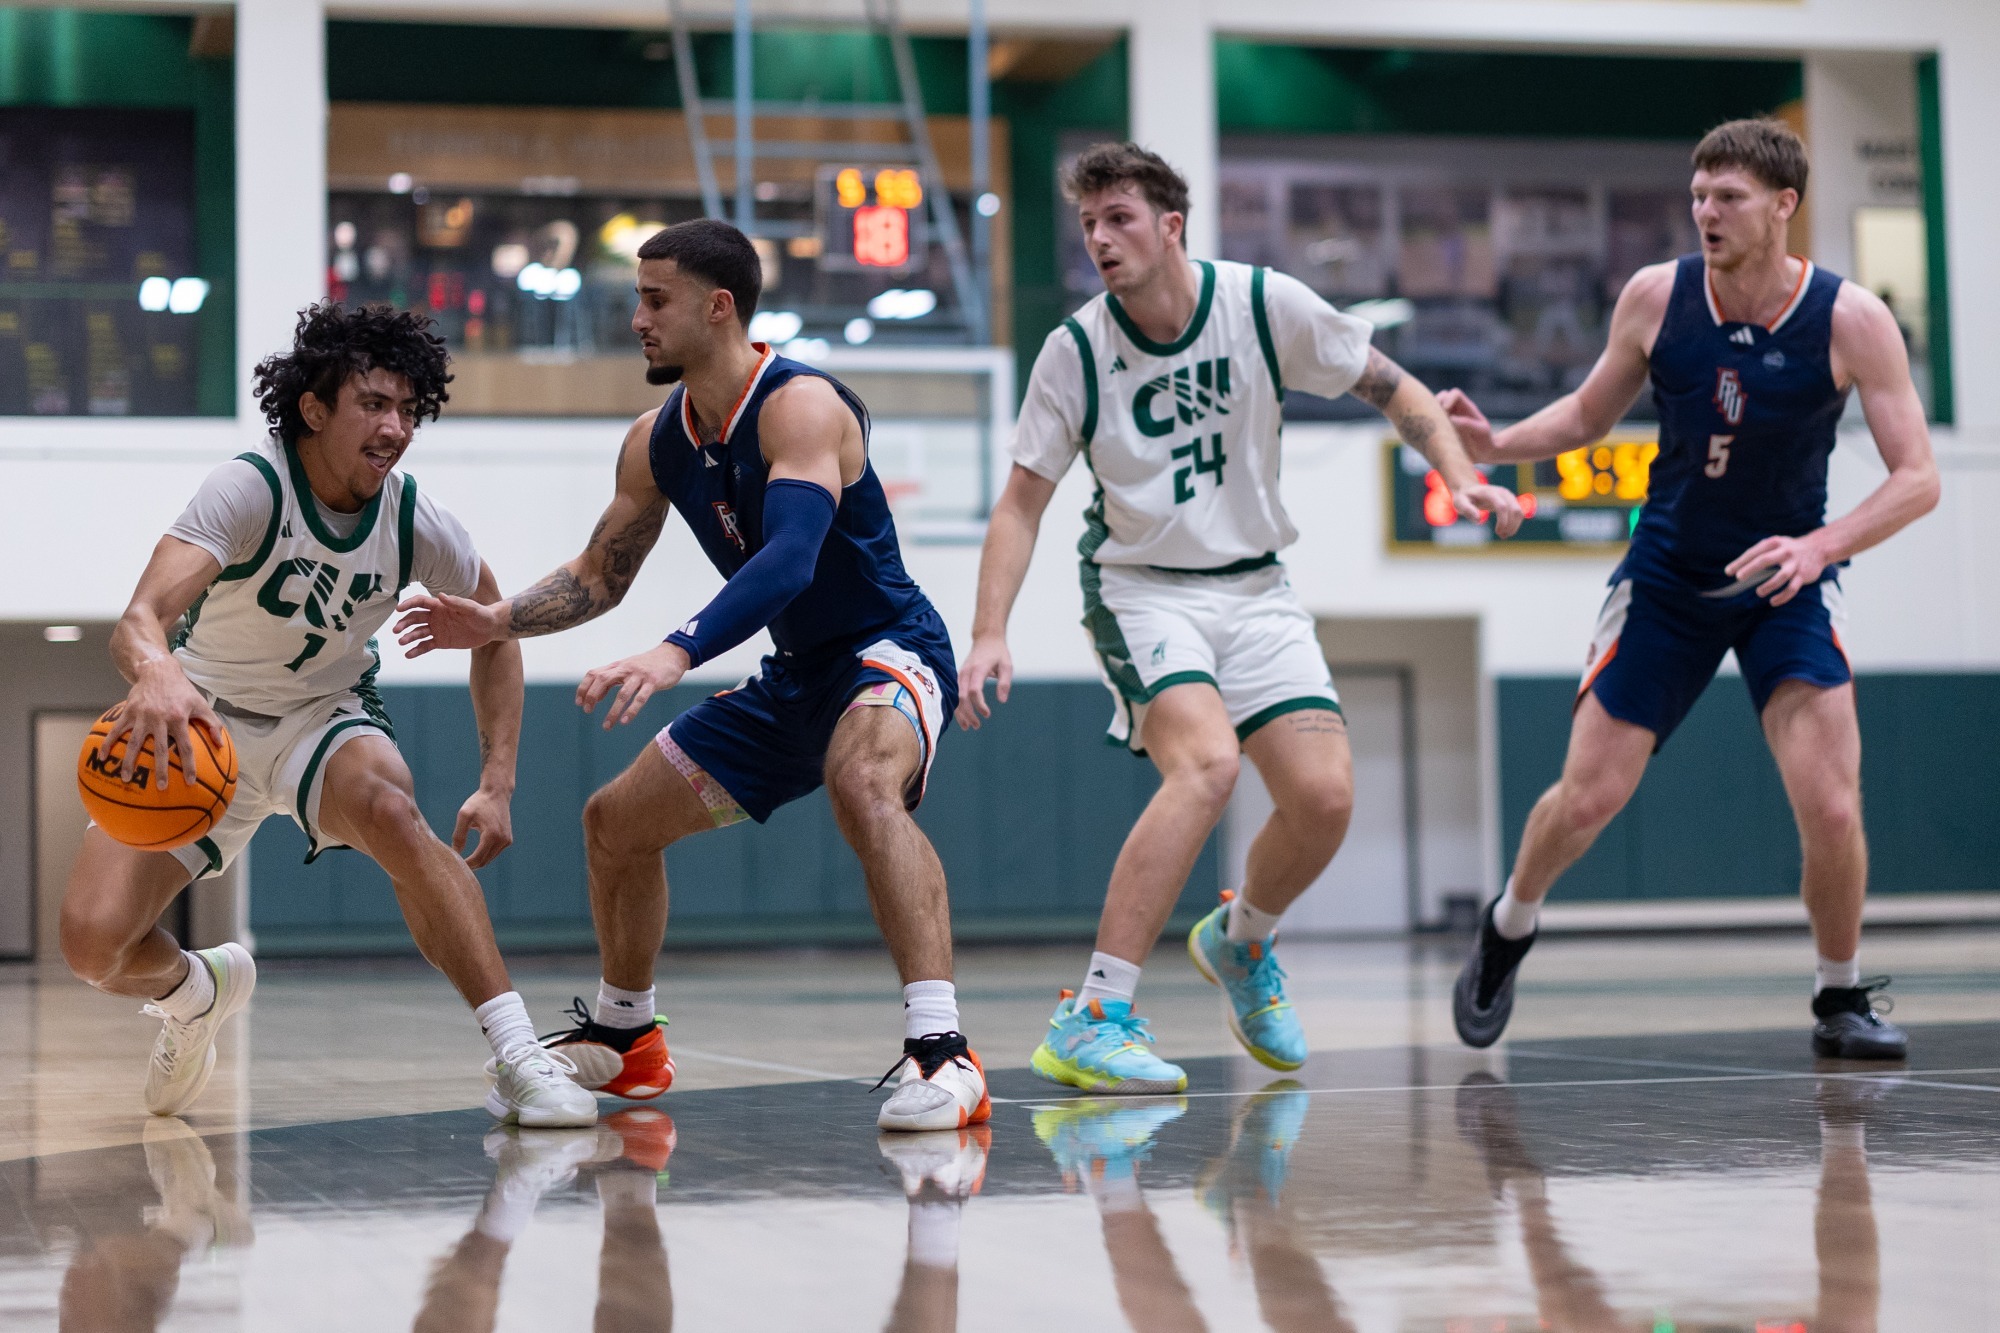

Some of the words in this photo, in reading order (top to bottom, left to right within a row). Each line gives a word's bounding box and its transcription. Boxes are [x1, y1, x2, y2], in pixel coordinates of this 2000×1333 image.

[1171, 432, 1227, 504] 24
[1704, 433, 1735, 479] 5
[283, 632, 328, 673] 1
